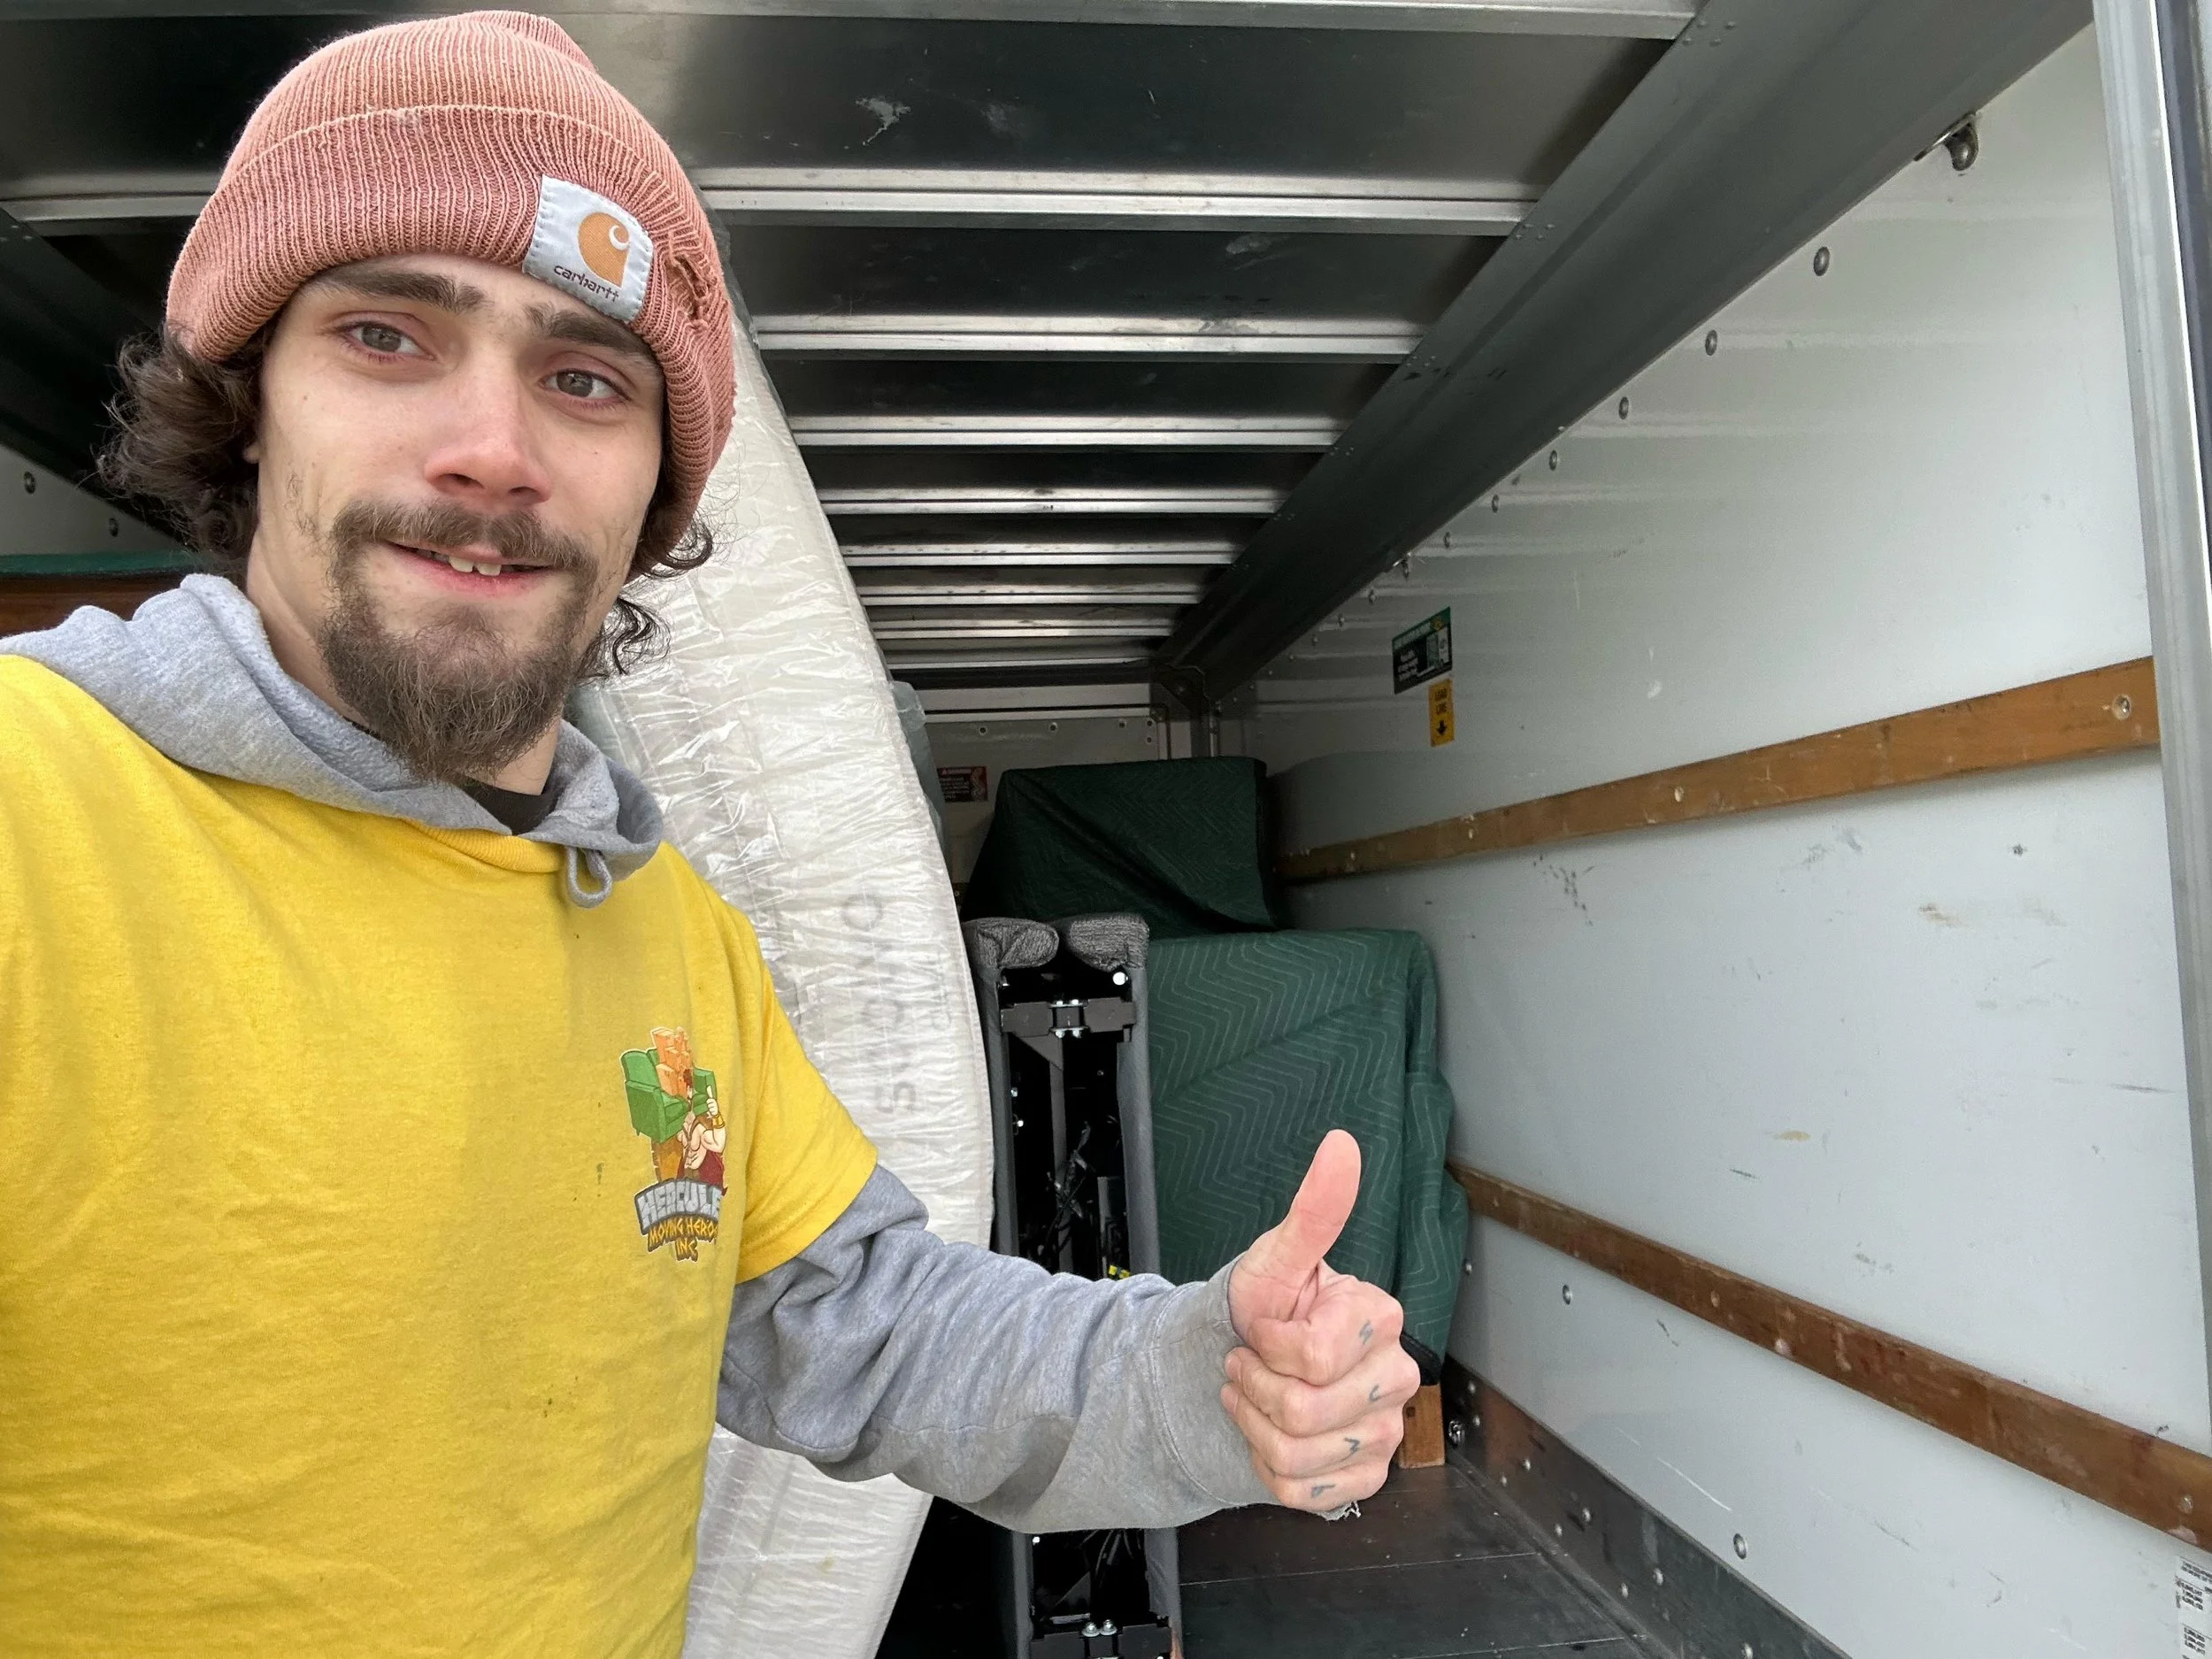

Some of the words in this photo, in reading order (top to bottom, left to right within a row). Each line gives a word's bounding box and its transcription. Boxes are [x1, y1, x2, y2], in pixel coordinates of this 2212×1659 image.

[553, 265, 620, 303] carhartt
[636, 1180, 722, 1231] HERCULE
[649, 1217, 684, 1243] MOVING
[686, 1217, 718, 1238] HERO
[676, 1238, 697, 1256] INC
